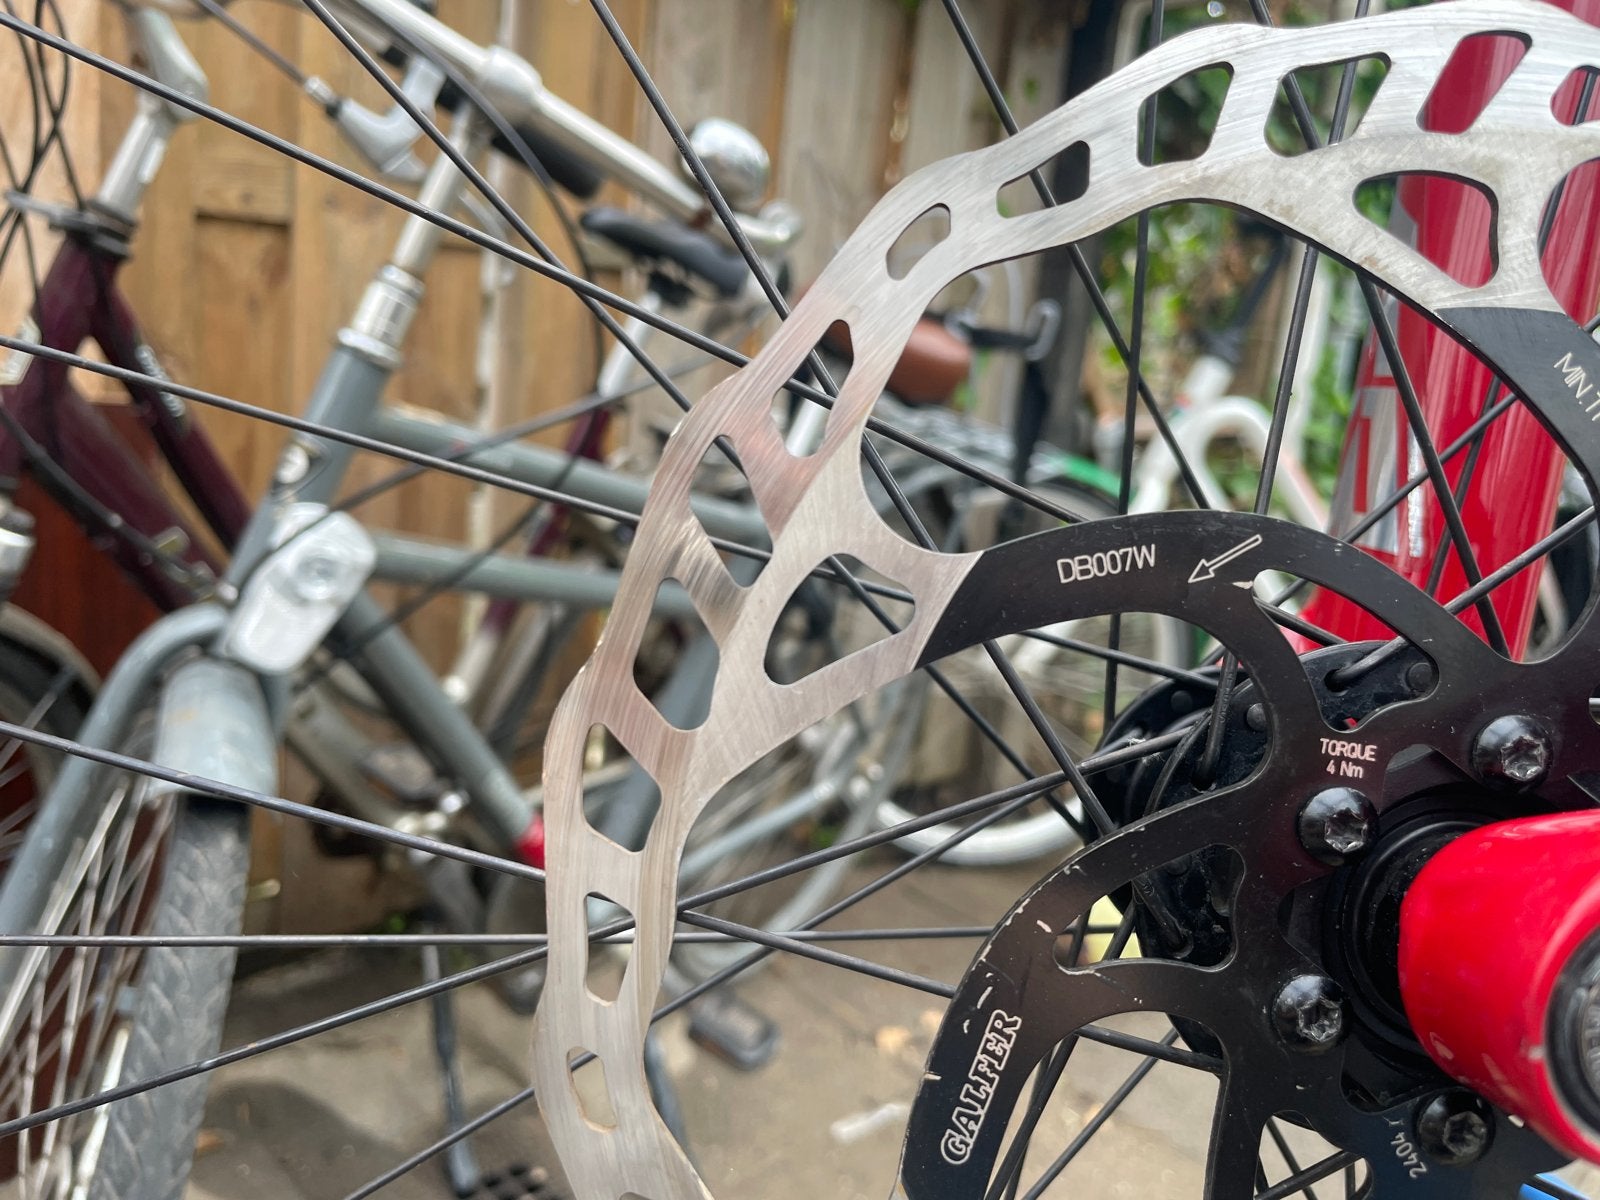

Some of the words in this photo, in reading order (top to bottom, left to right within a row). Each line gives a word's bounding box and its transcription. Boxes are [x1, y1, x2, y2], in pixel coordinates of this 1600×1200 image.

[1056, 543, 1156, 584] DB007W
[1320, 737, 1378, 762] TORQUE
[1326, 759, 1336, 775] 4
[1340, 760, 1364, 778] Nm
[940, 1009, 1023, 1165] GALFER
[1390, 1131, 1428, 1178] 2404
